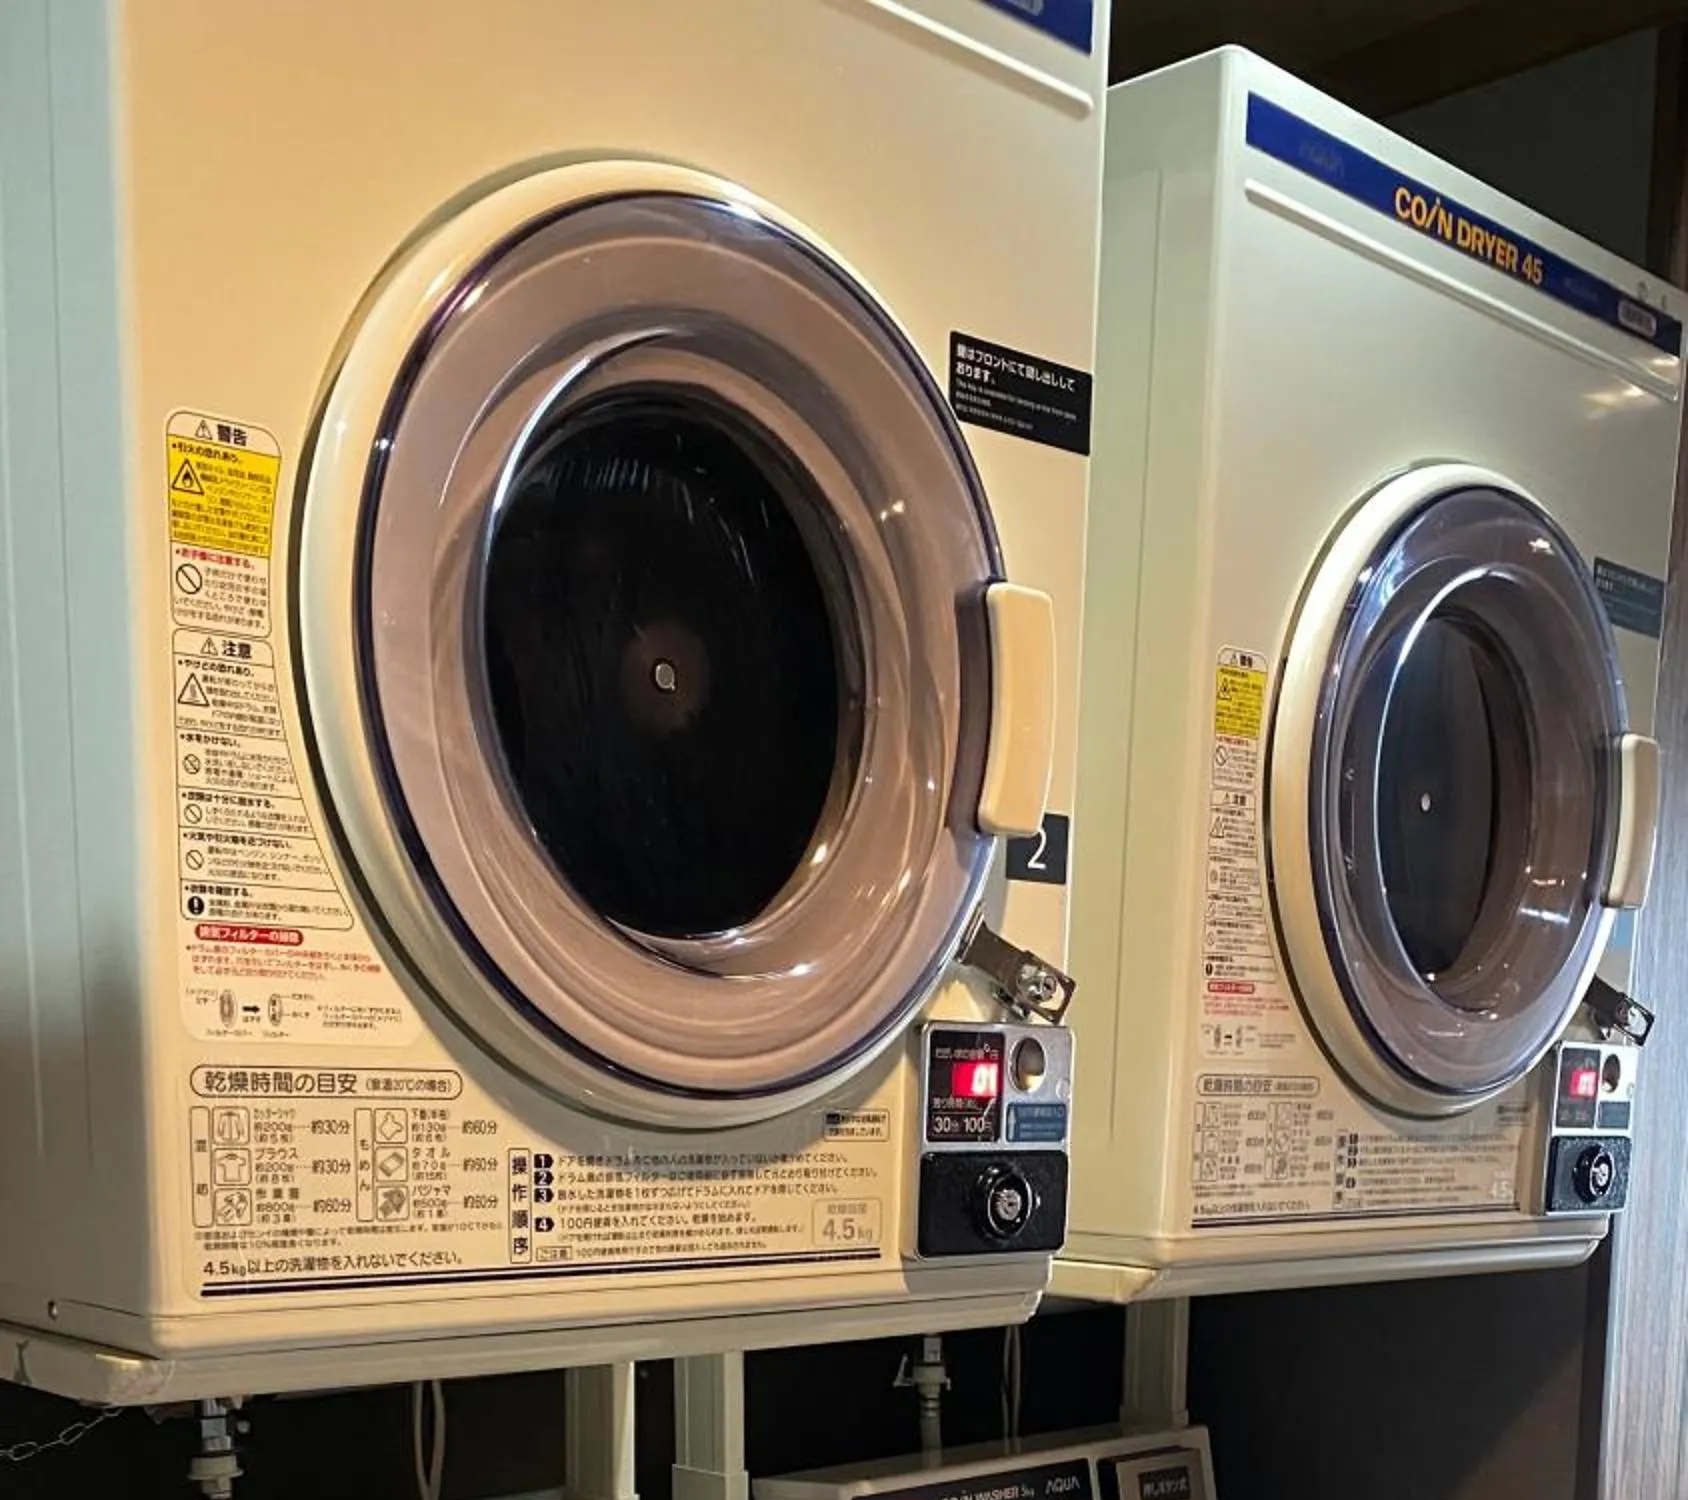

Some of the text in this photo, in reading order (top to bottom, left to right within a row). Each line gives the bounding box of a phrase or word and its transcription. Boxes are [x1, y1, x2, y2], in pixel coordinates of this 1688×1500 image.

[1456, 217, 1519, 273] DRYER
[1521, 252, 1544, 286] 45
[956, 361, 996, 385] おります。
[222, 639, 252, 660] 注意
[1027, 827, 1047, 869] 2
[204, 1071, 357, 1094] 乾燥時間の目安
[538, 1172, 548, 1185] 2
[511, 1155, 530, 1256] 操作順序
[538, 1190, 548, 1202] 3
[538, 1219, 549, 1232] 4
[1045, 1475, 1080, 1495] AQUA
